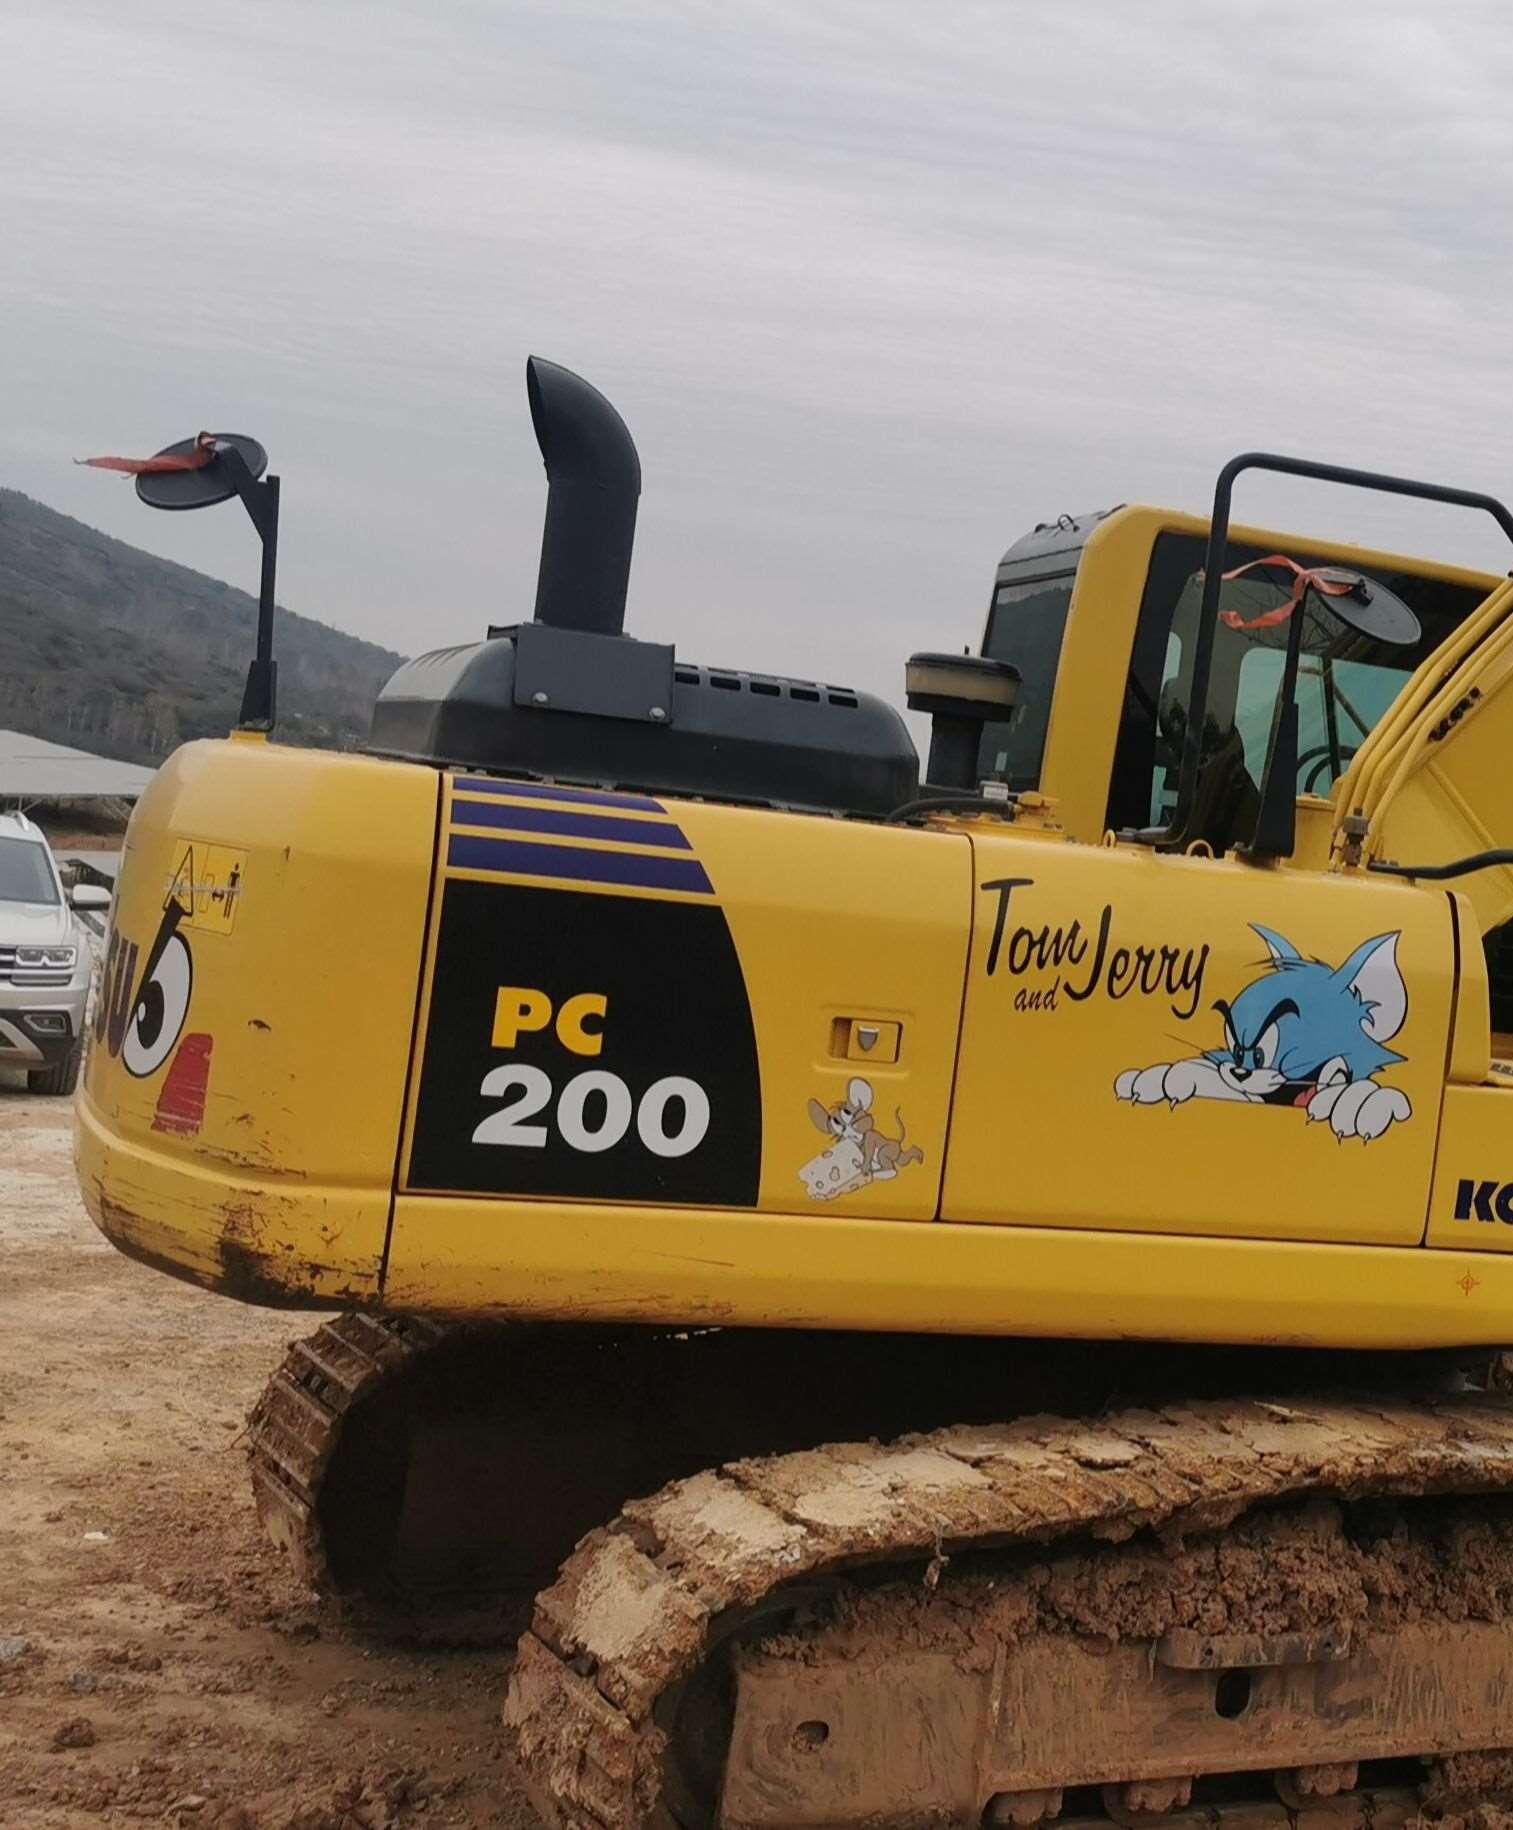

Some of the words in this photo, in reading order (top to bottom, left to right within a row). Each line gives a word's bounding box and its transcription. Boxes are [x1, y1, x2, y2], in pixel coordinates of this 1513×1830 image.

[980, 879, 1088, 976] Tom
[1063, 905, 1210, 1020] Jerry
[491, 986, 608, 1056] PC
[1014, 976, 1061, 1012] and
[472, 1064, 710, 1157] 200
